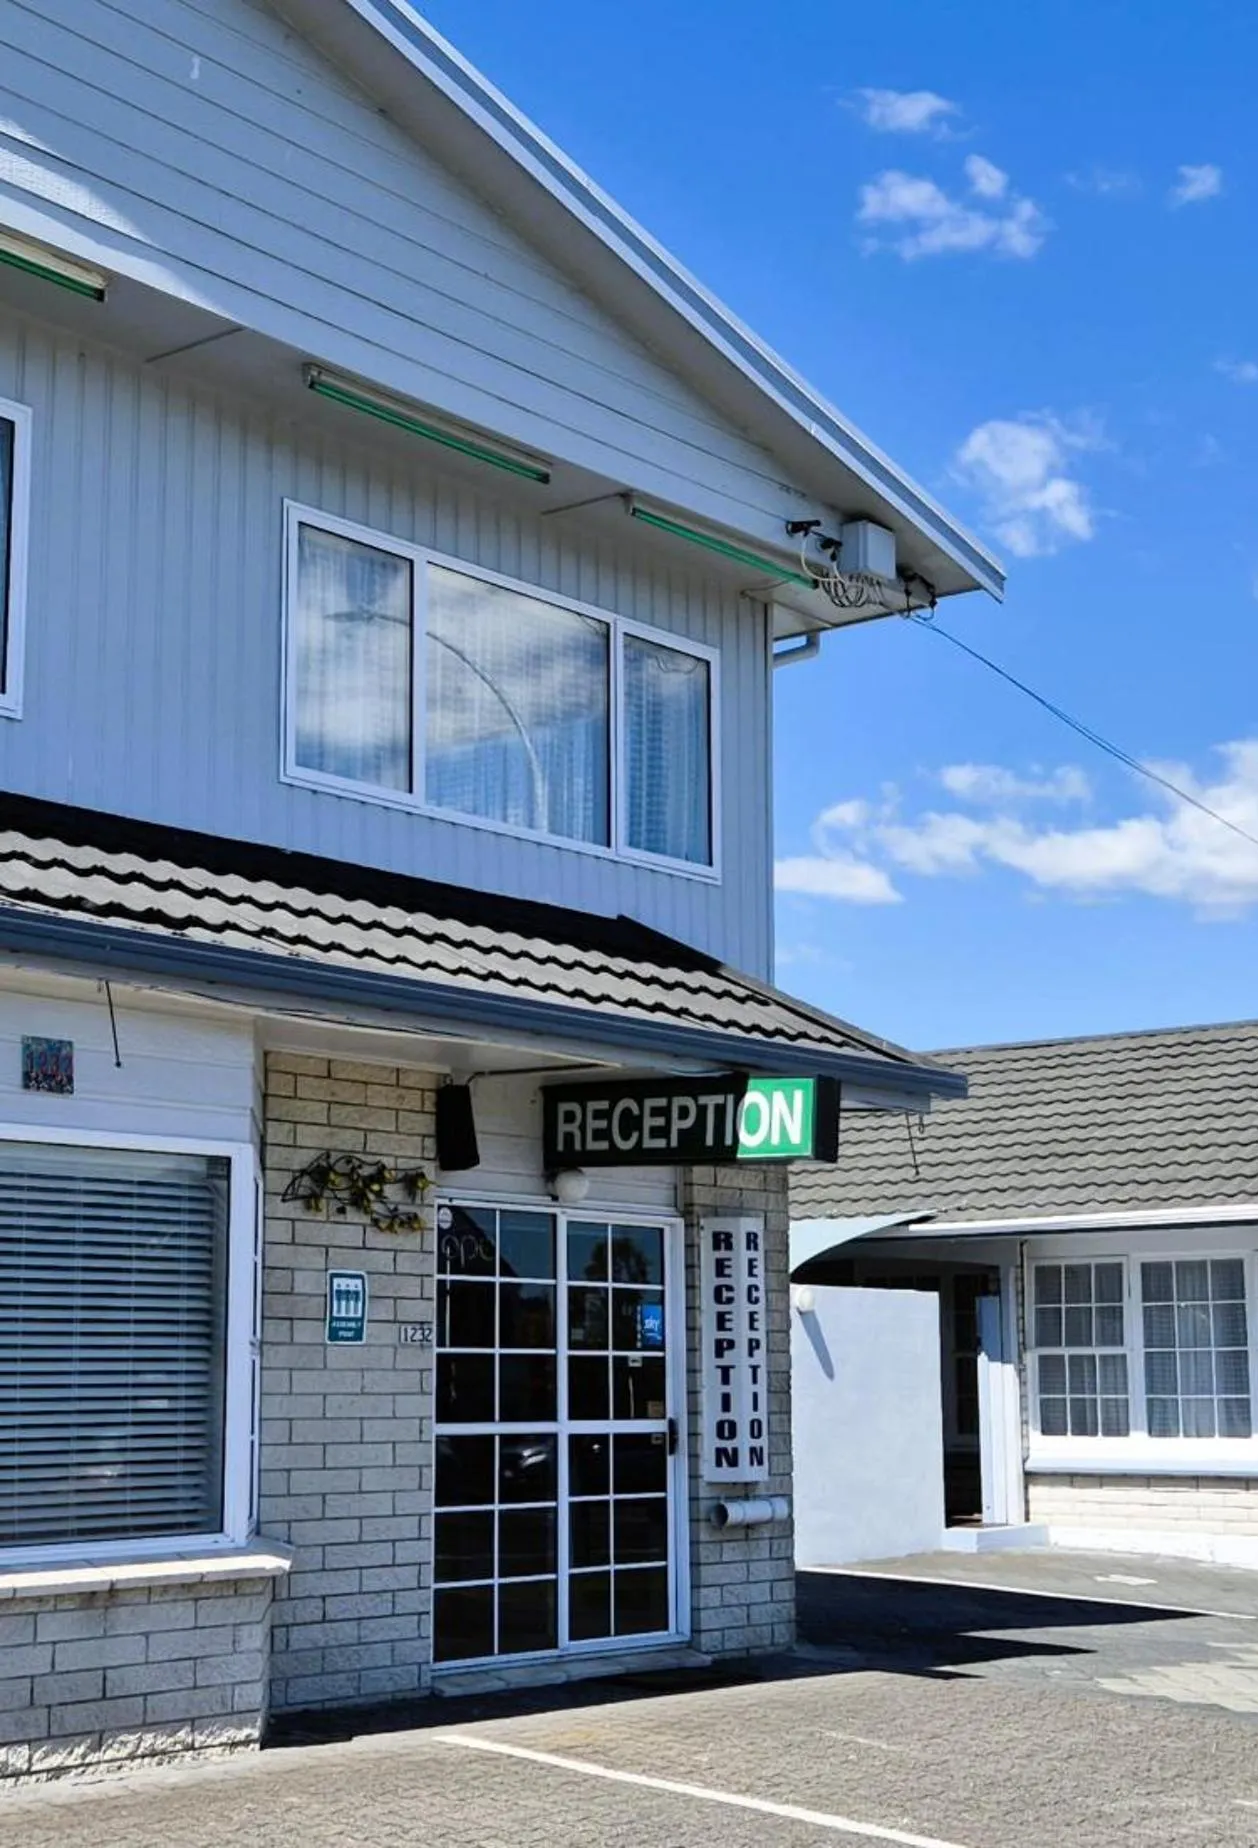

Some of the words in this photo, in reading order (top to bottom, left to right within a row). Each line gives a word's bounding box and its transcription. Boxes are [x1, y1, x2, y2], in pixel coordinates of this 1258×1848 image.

[556, 1089, 801, 1152] RECEPTION
[403, 1327, 433, 1343] 1232
[711, 1231, 739, 1468] RECEPTION
[745, 1231, 764, 1467] RECEPTION
